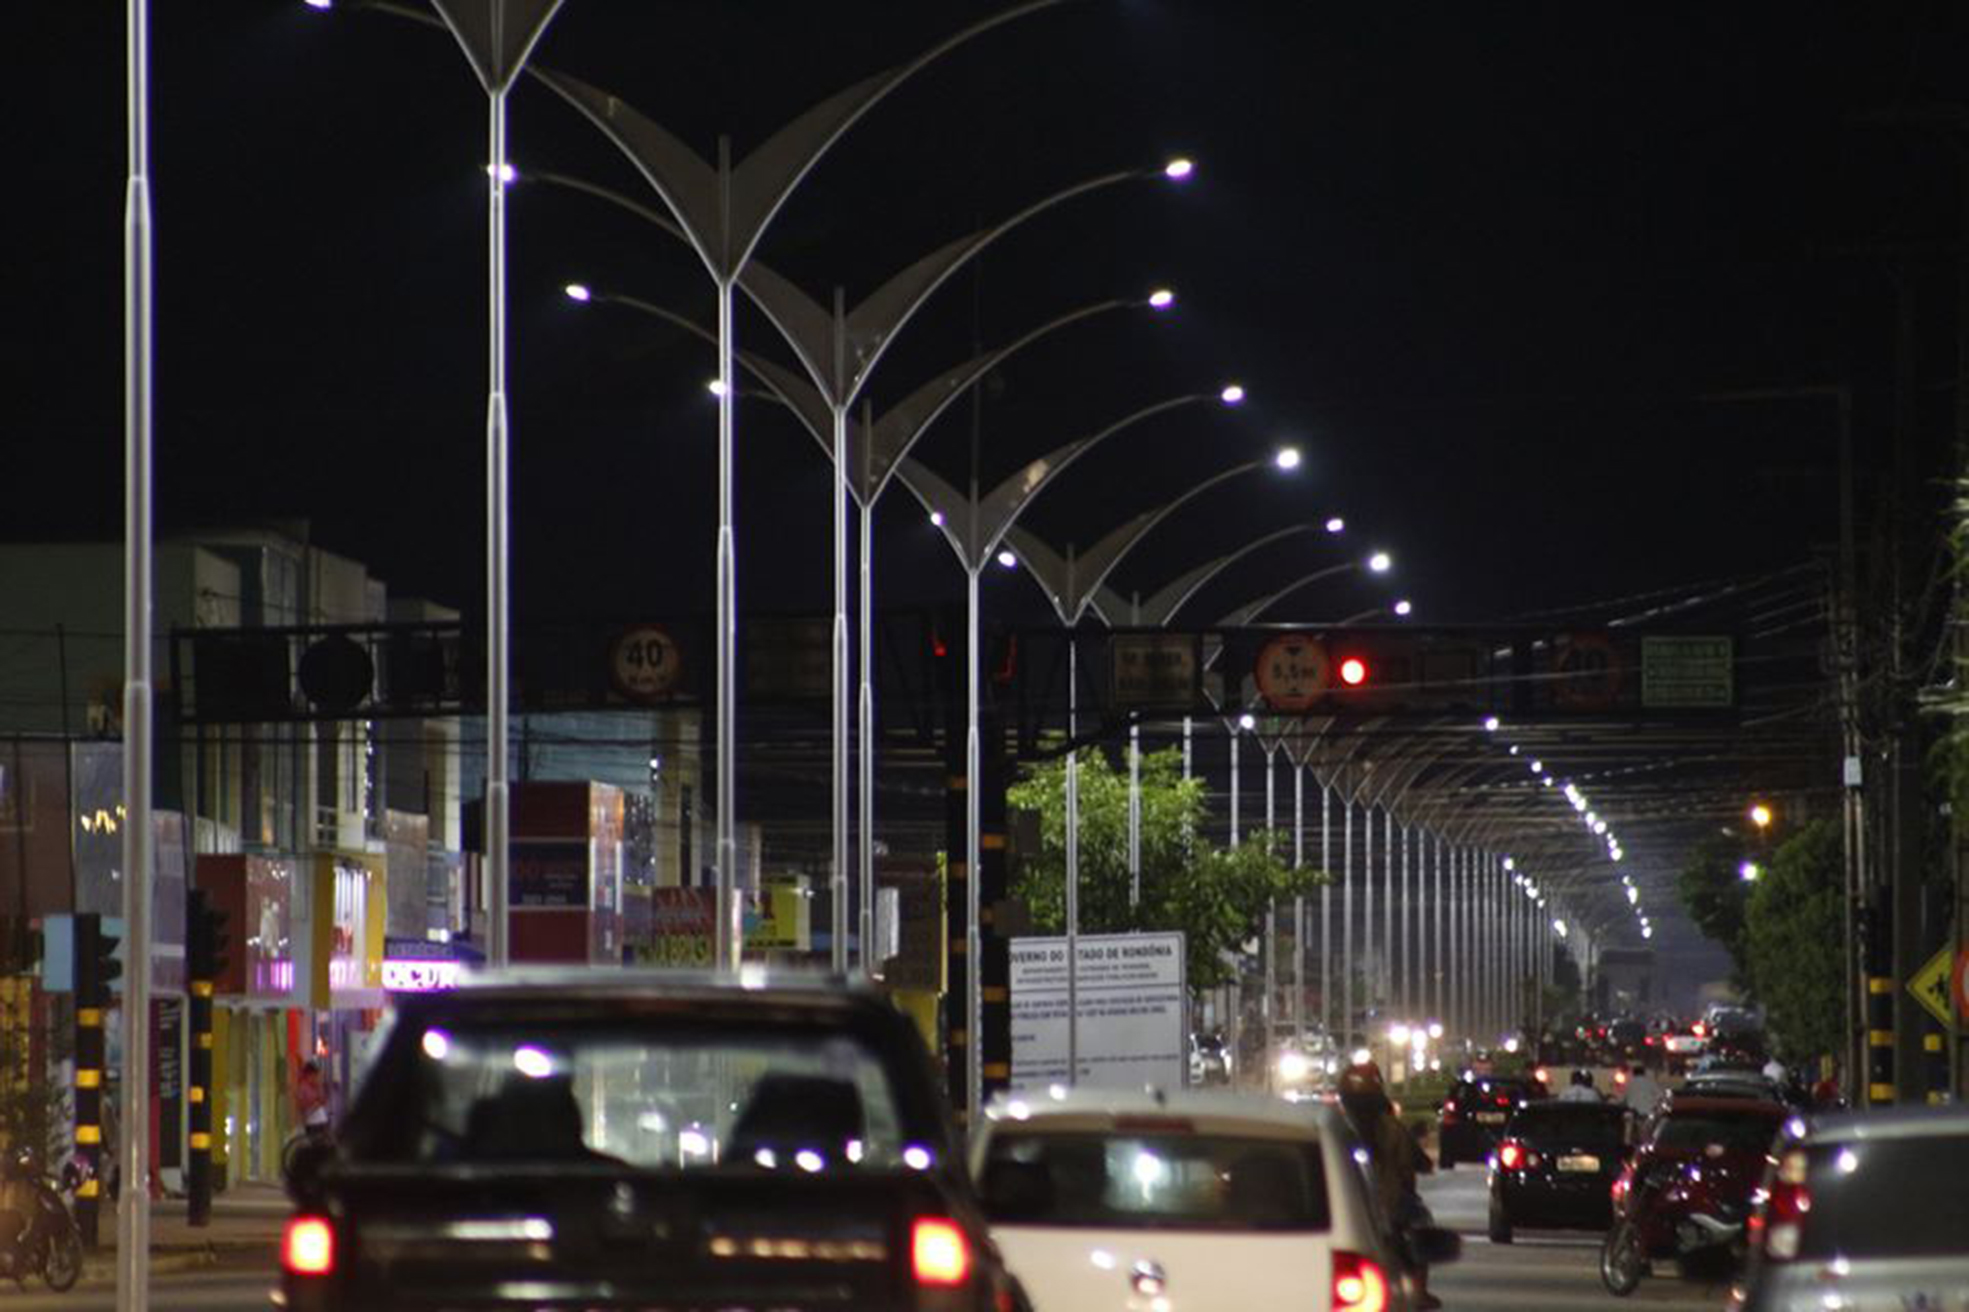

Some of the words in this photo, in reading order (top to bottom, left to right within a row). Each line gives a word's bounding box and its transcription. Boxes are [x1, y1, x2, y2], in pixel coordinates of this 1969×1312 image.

[626, 639, 664, 668] 40
[1050, 949, 1065, 963] DO
[1106, 946, 1119, 960] DE
[1122, 943, 1172, 958] RONDÔNIA
